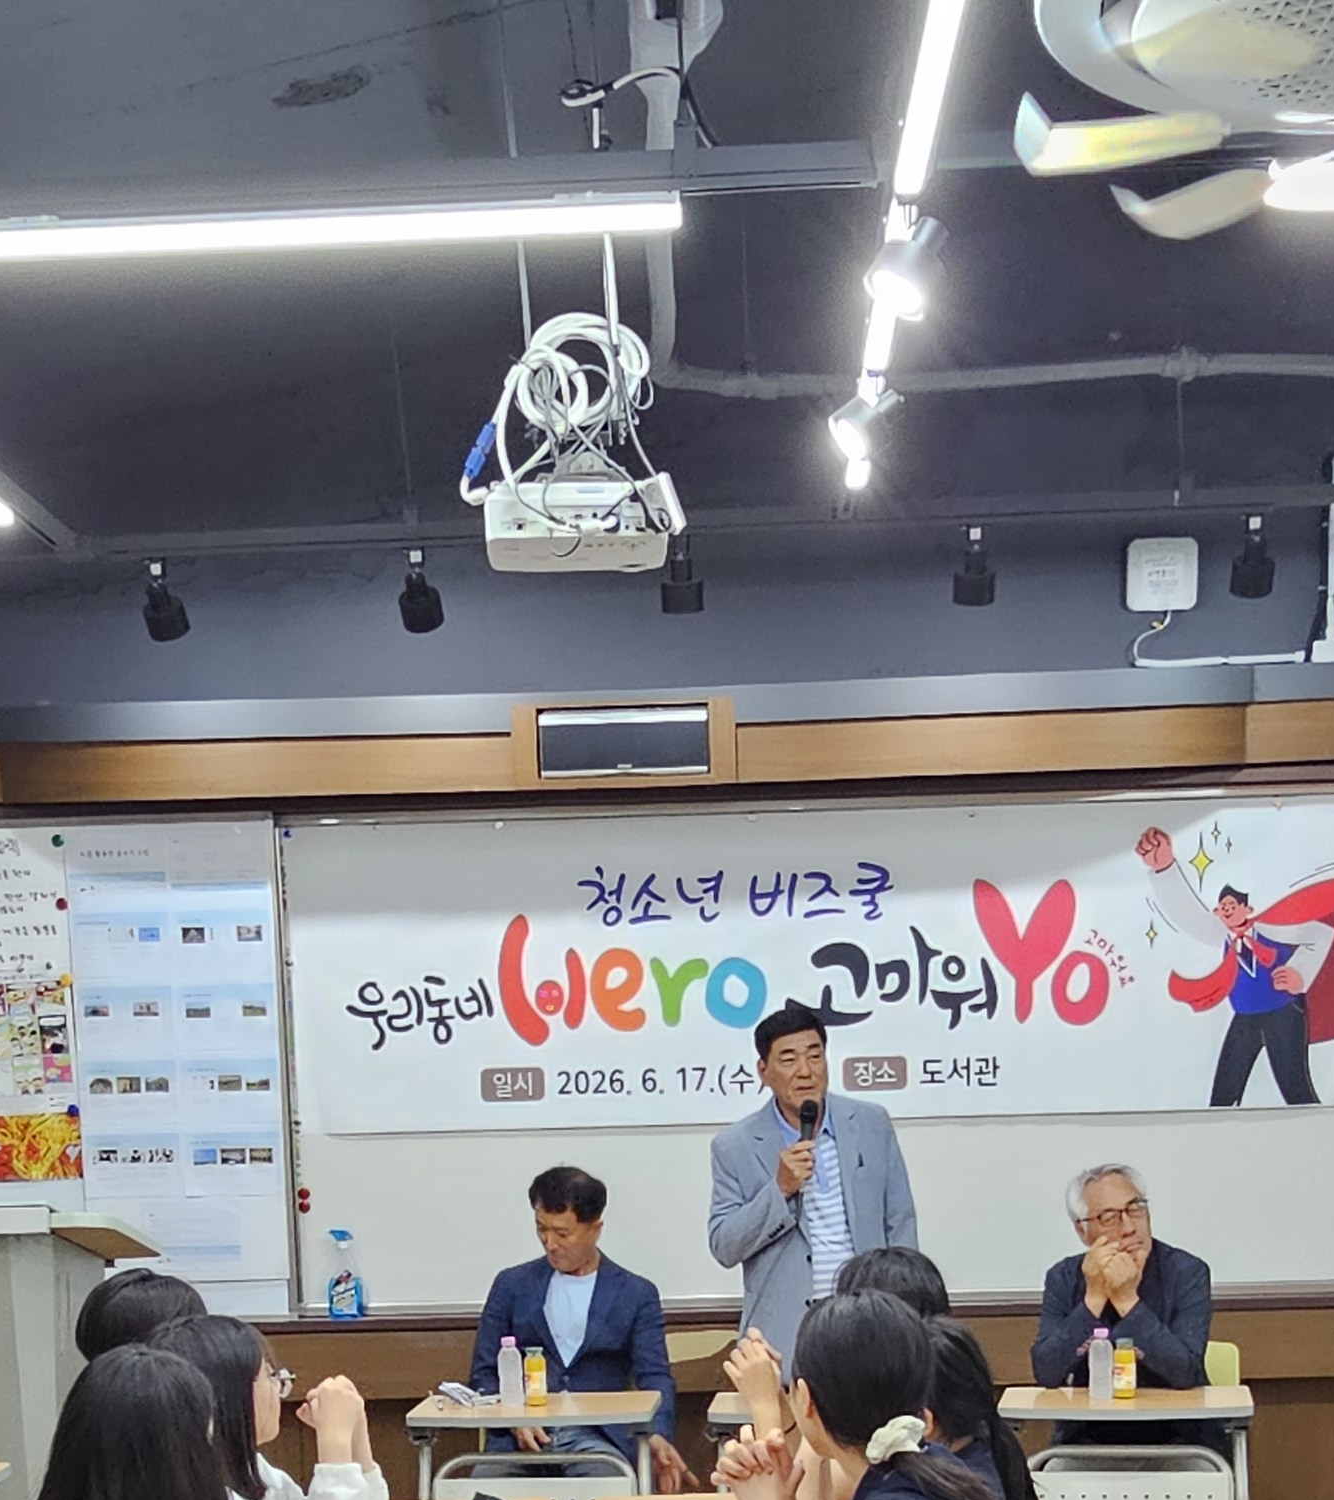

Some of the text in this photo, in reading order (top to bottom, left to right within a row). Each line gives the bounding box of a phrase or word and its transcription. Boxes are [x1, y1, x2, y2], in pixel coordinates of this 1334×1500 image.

[577, 861, 894, 927] 청소년 비즈쿨
[345, 976, 493, 1051] 우리동네
[498, 914, 767, 1046] Hero
[1083, 929, 1135, 989] 고마워요
[492, 1072, 534, 1098] 일시
[556, 1069, 632, 1096] 2026.
[641, 1068, 665, 1094] 6.
[853, 1056, 1001, 1087] 장소 도서관
